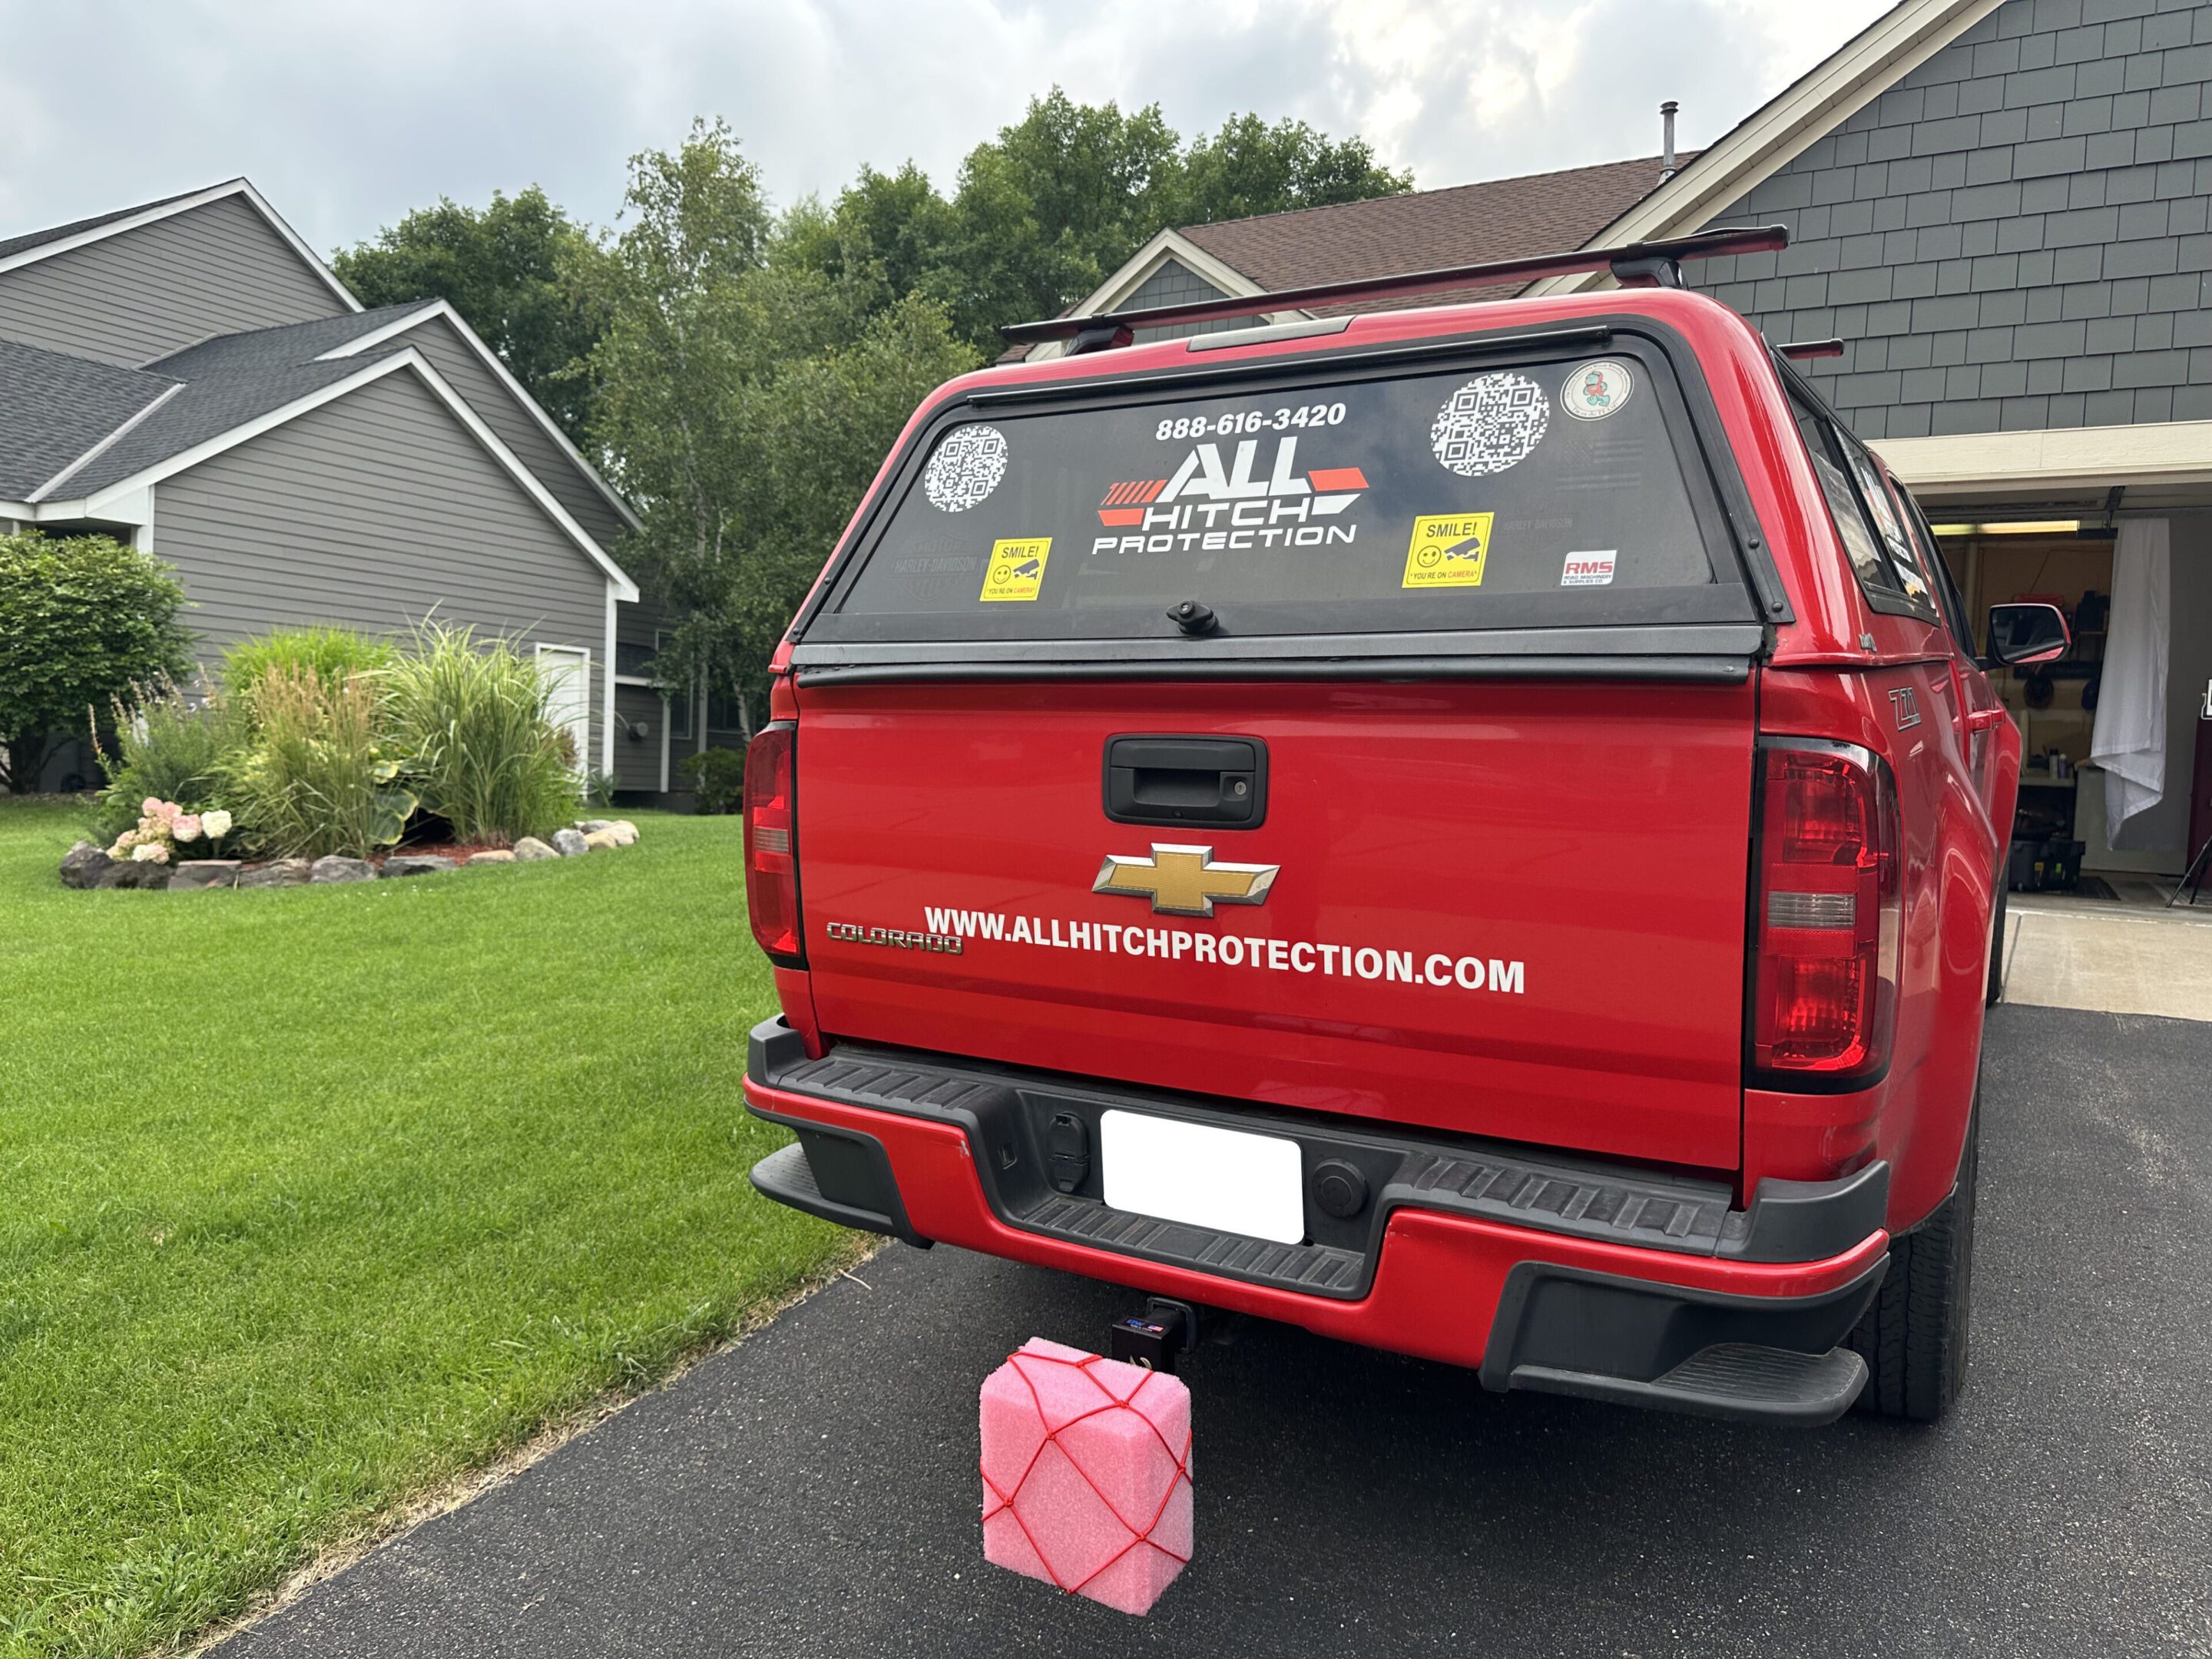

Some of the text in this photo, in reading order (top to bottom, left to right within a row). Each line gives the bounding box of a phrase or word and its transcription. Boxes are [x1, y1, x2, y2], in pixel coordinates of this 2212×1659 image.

[1155, 402, 1346, 441] 888-616-3420
[1154, 436, 1312, 503] ALL
[1142, 497, 1310, 531] HITCH
[1426, 522, 1477, 538] SMILE!
[1002, 545, 1039, 558] SMILE!
[1091, 524, 1357, 556] PROTECTION
[1565, 561, 1614, 575] RMS
[826, 922, 964, 955] COLORADO
[924, 906, 1525, 994] WWW.ALLHITCHPROTECTION.COM
